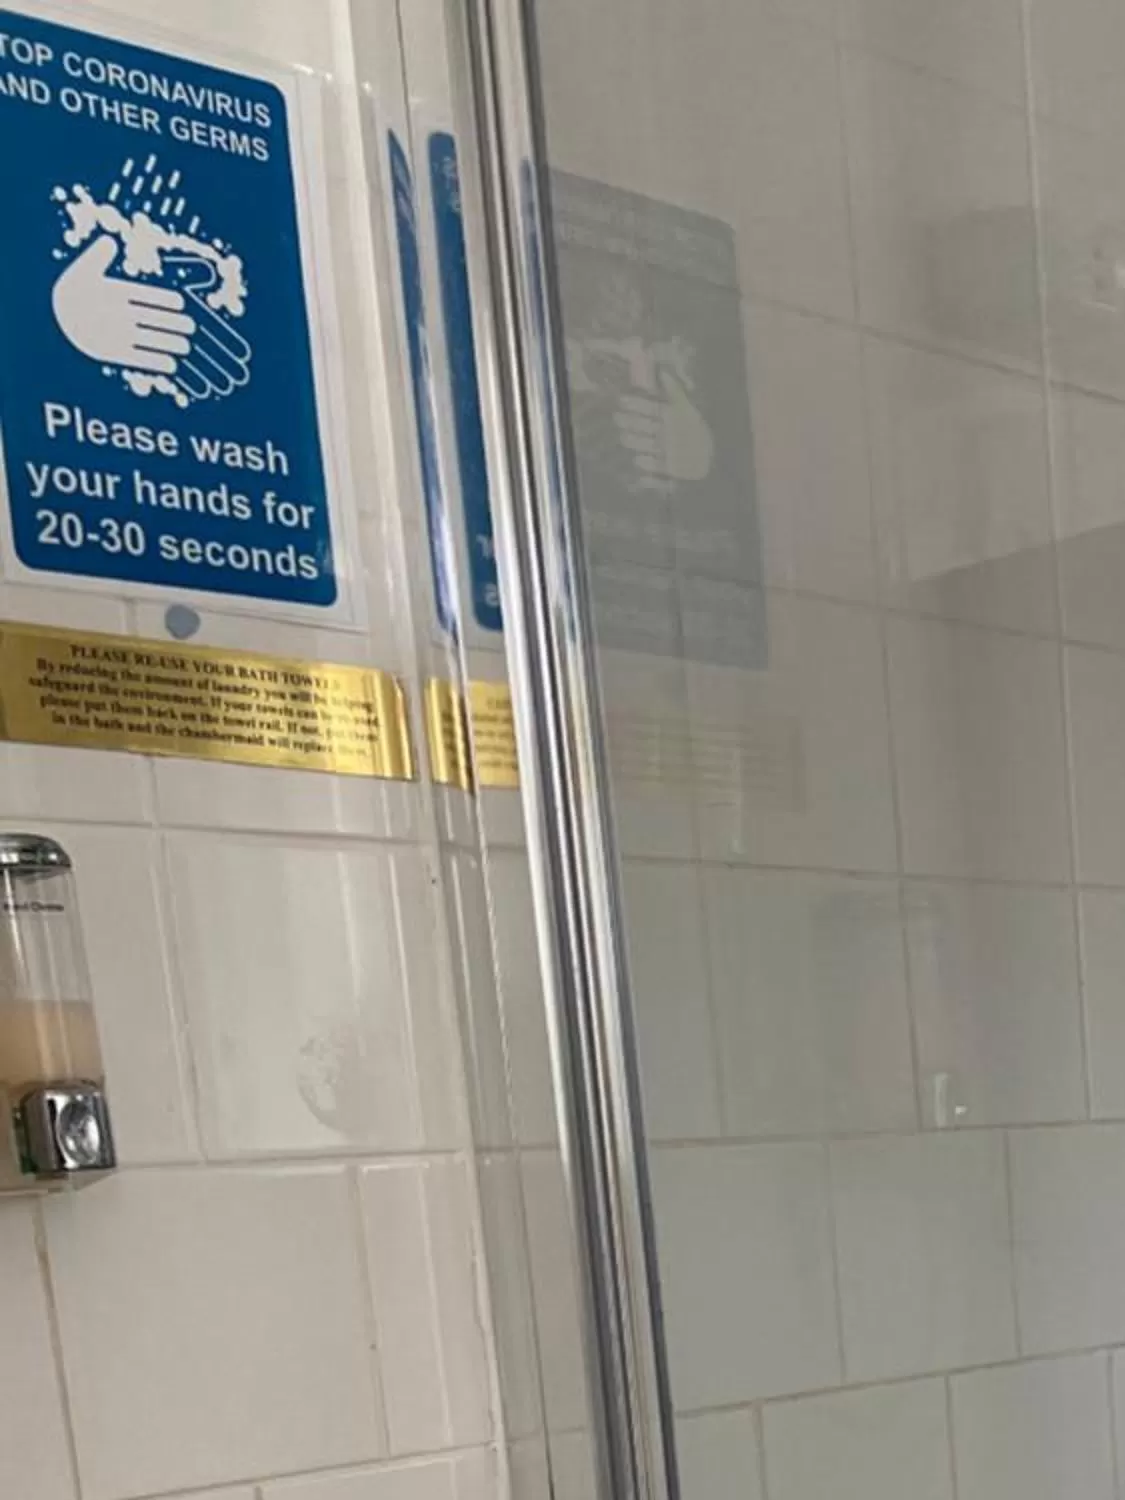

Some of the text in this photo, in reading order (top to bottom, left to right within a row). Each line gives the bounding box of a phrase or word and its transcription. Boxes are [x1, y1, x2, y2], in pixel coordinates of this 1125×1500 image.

[62, 51, 272, 128] CORONAVIRUS
[60, 87, 162, 135] OTHER
[169, 116, 270, 162] GERMS
[43, 402, 289, 476] Please wash
[26, 462, 316, 530] your hands for
[35, 509, 319, 580] 20-30 seconds
[36, 658, 54, 673] By
[121, 669, 142, 681] the
[69, 644, 131, 664] PLEASE
[192, 659, 235, 677] YOUR
[239, 666, 278, 684] BATH
[98, 682, 119, 697] the
